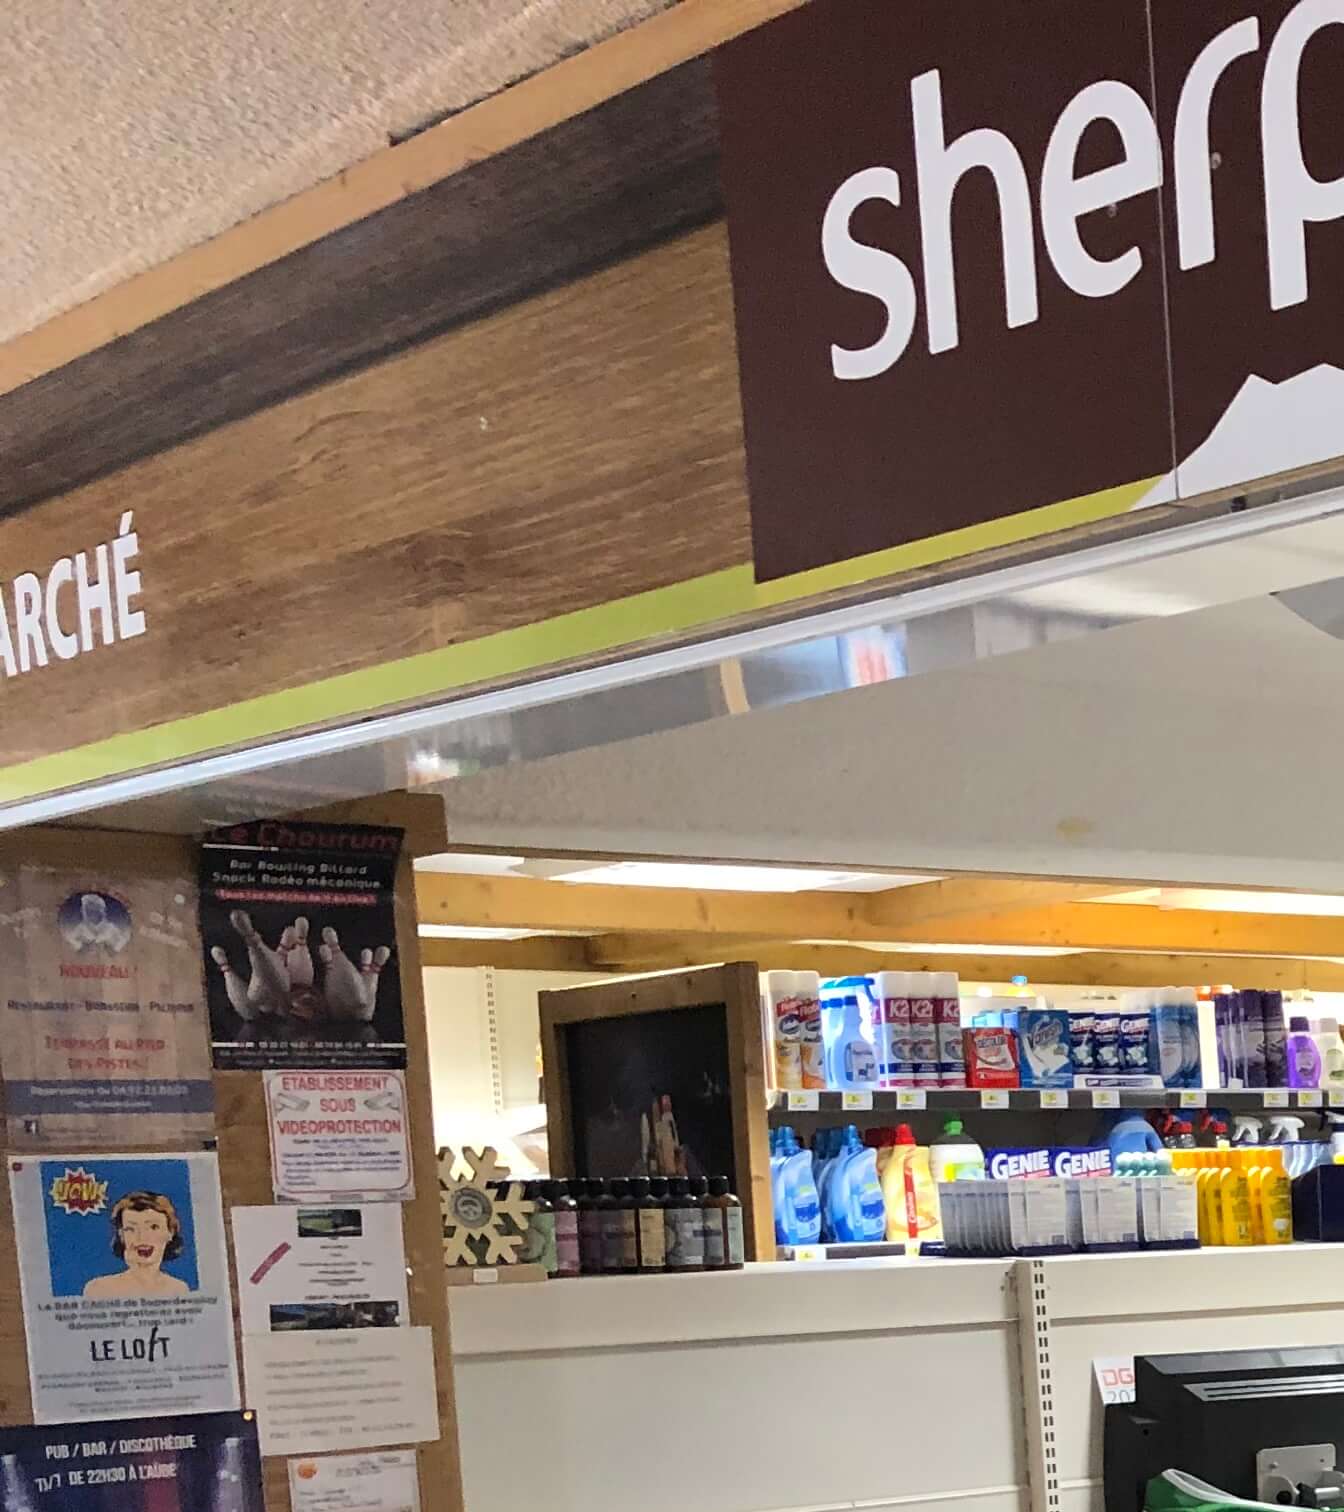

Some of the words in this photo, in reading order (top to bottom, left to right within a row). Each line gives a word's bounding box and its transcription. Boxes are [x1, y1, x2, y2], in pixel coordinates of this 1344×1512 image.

[282, 1076, 388, 1091] ETABLISSEMENT
[319, 1099, 356, 1112] SOUS
[991, 1150, 1050, 1179] GENIE
[1055, 1148, 1112, 1178] GENIE
[90, 1339, 116, 1362] LE
[46, 1444, 69, 1460] PUB
[82, 1441, 107, 1457] BAR
[68, 1471, 85, 1487] DE
[87, 1467, 127, 1485] 22H30
